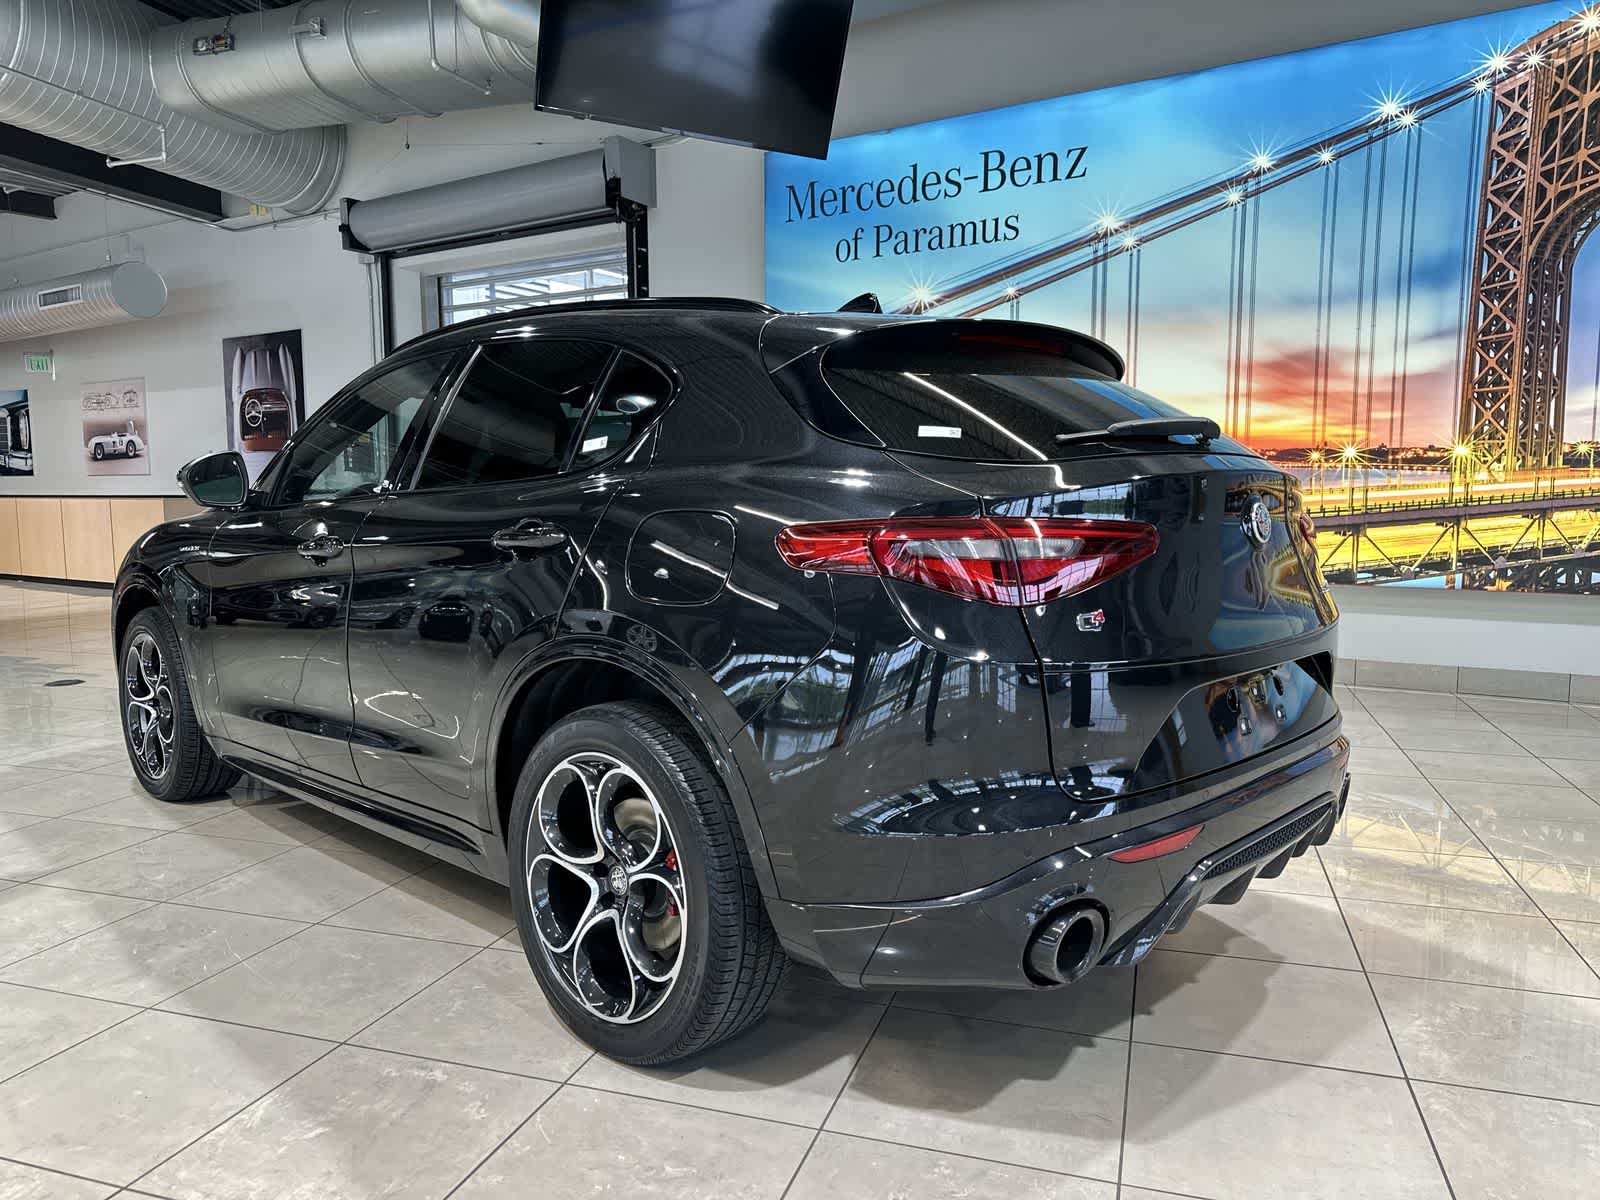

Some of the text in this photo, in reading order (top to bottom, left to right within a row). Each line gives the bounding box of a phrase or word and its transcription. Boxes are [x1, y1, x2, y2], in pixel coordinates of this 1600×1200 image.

[785, 146, 1088, 222] Mercedes-Benz
[836, 213, 1020, 263] of Paramus
